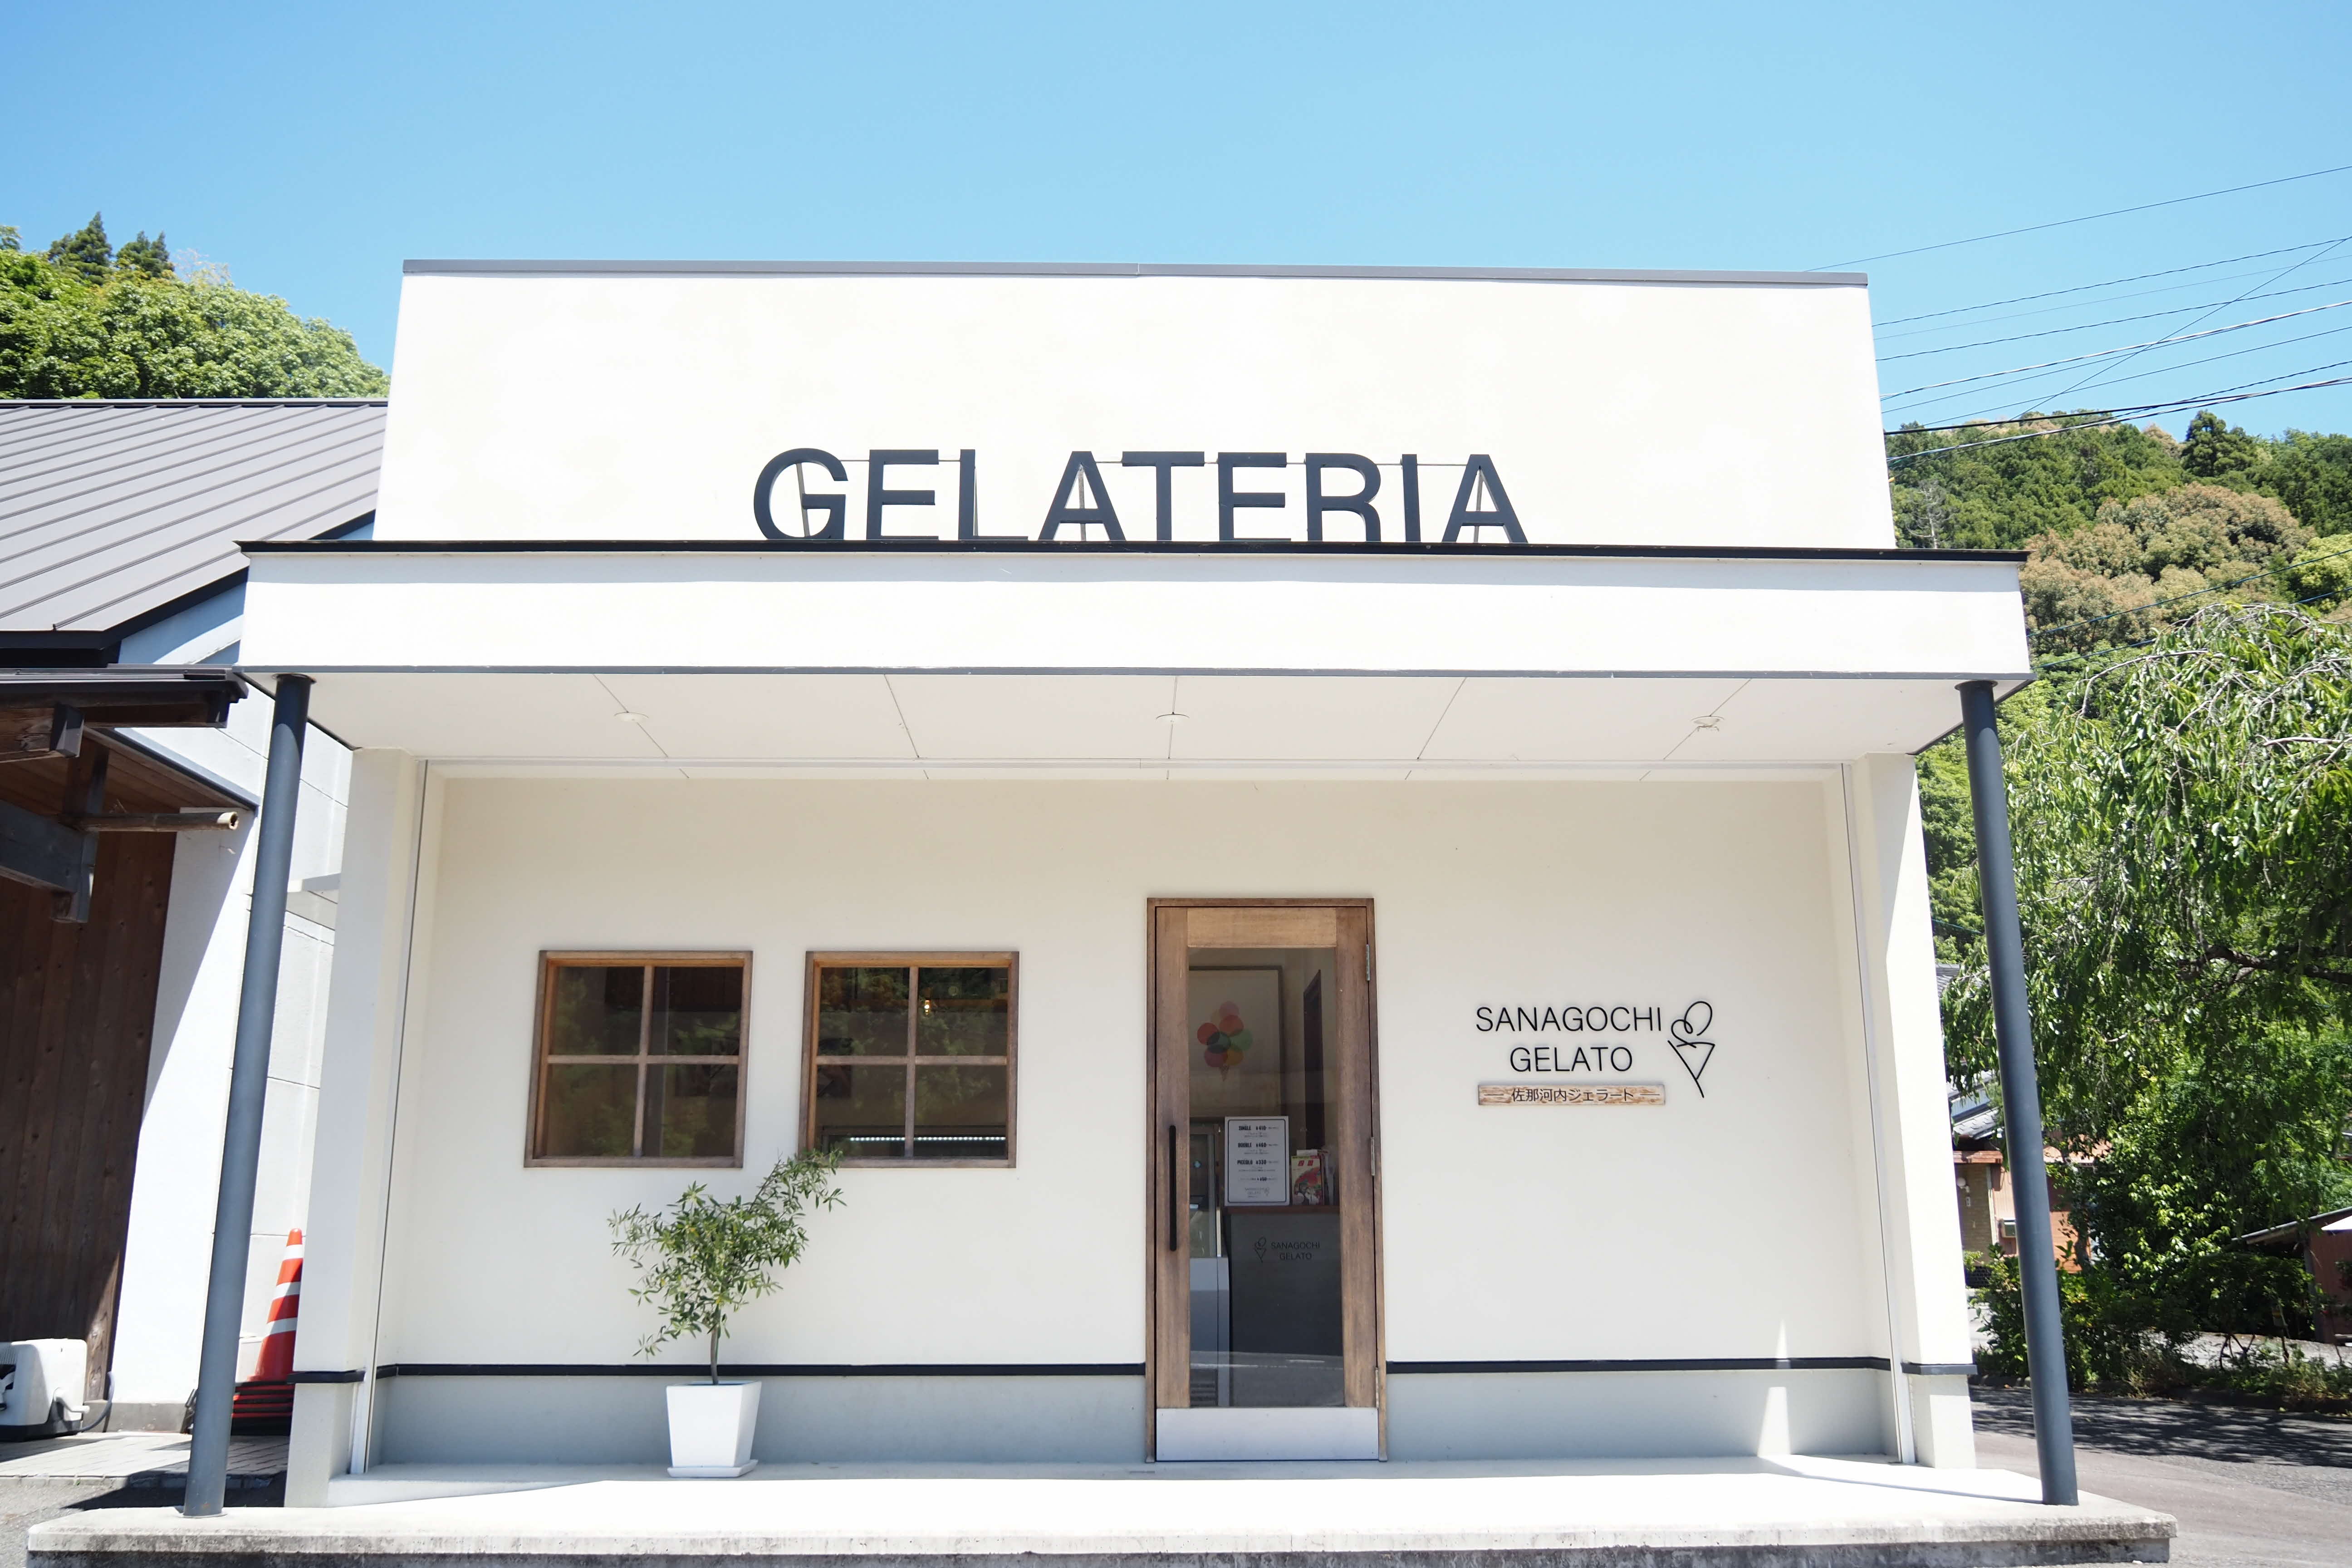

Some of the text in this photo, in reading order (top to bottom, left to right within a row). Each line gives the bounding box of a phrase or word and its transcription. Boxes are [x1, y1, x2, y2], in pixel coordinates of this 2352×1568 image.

[753, 448, 1529, 544] GELATERIA
[1476, 1006, 1661, 1032] SANAGOCHI
[1510, 1046, 1632, 1072] GELATO
[1511, 1088, 1634, 1102] 佐那河内ジェラート
[1271, 1241, 1320, 1250] SANAGOCHI
